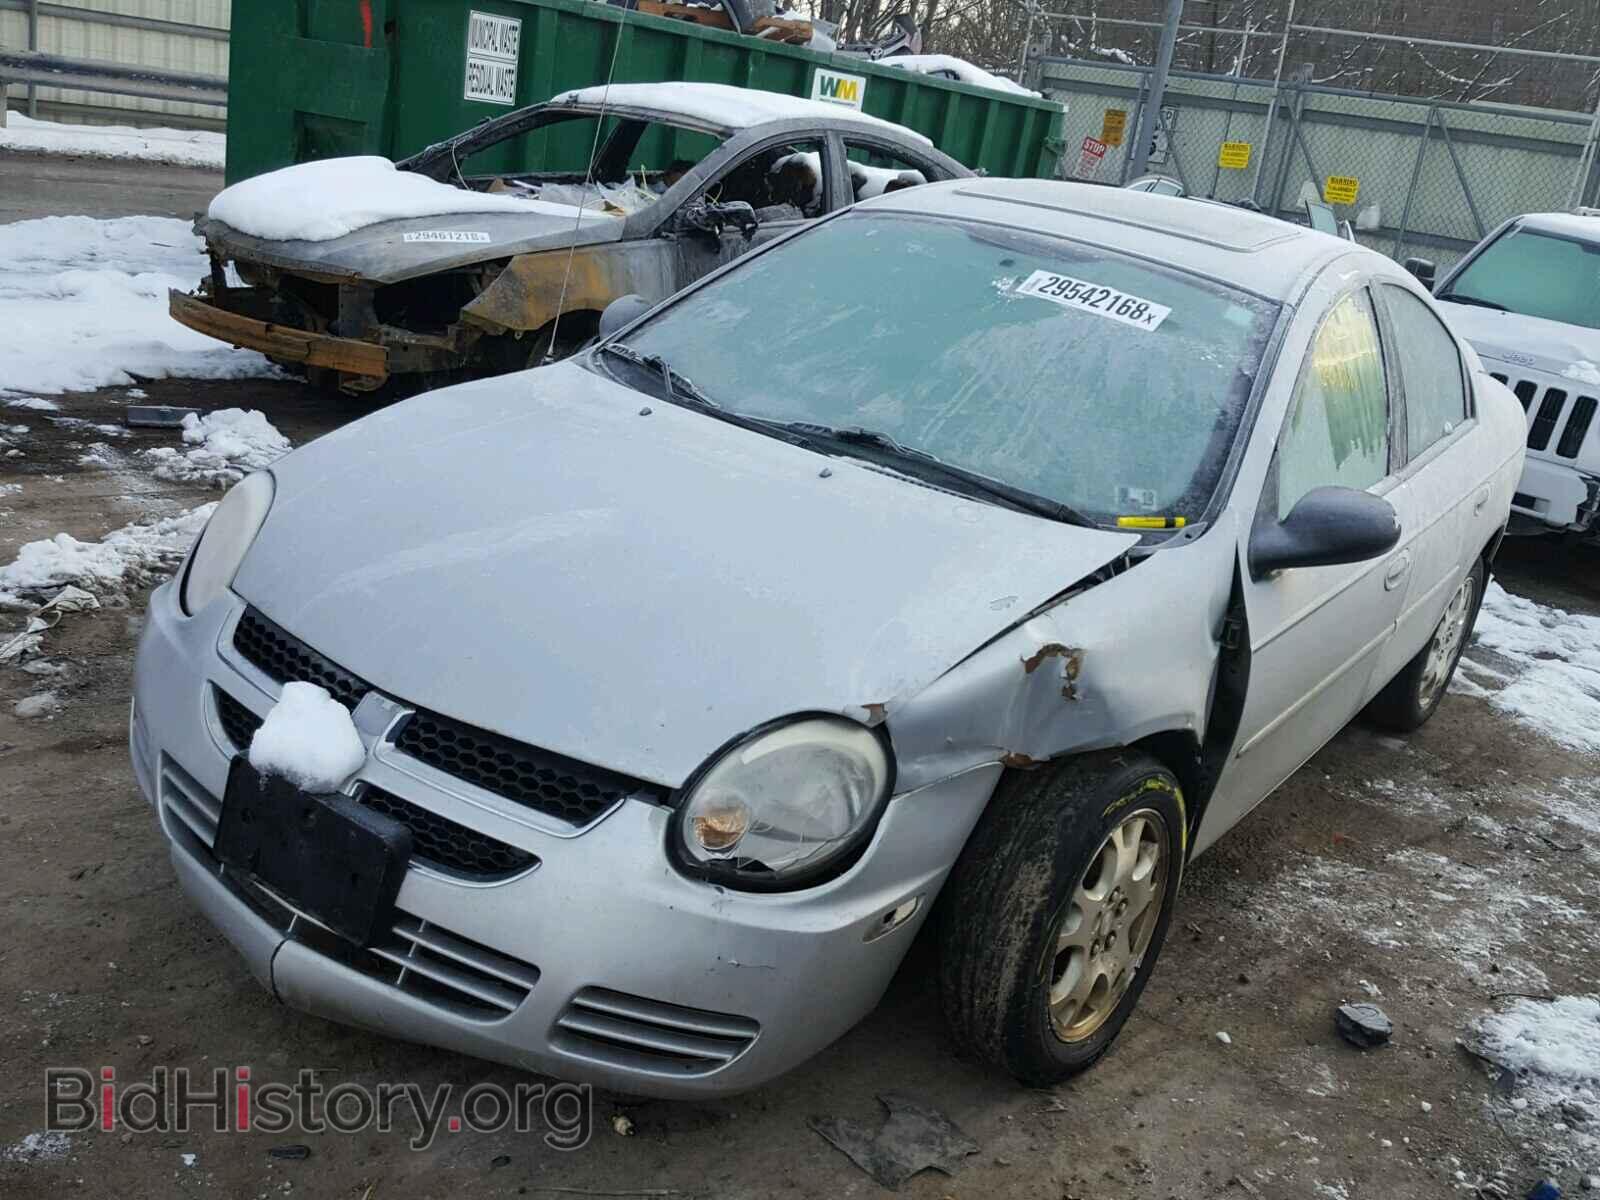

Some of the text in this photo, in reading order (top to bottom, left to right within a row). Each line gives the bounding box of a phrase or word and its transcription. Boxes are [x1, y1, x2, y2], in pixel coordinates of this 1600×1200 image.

[472, 18, 518, 56] MUNICIPAL WASTE
[467, 62, 515, 98] RESIDUAL WASTE
[820, 75, 857, 102] WM
[1083, 140, 1106, 156] STOP
[1330, 176, 1358, 187] WARNING
